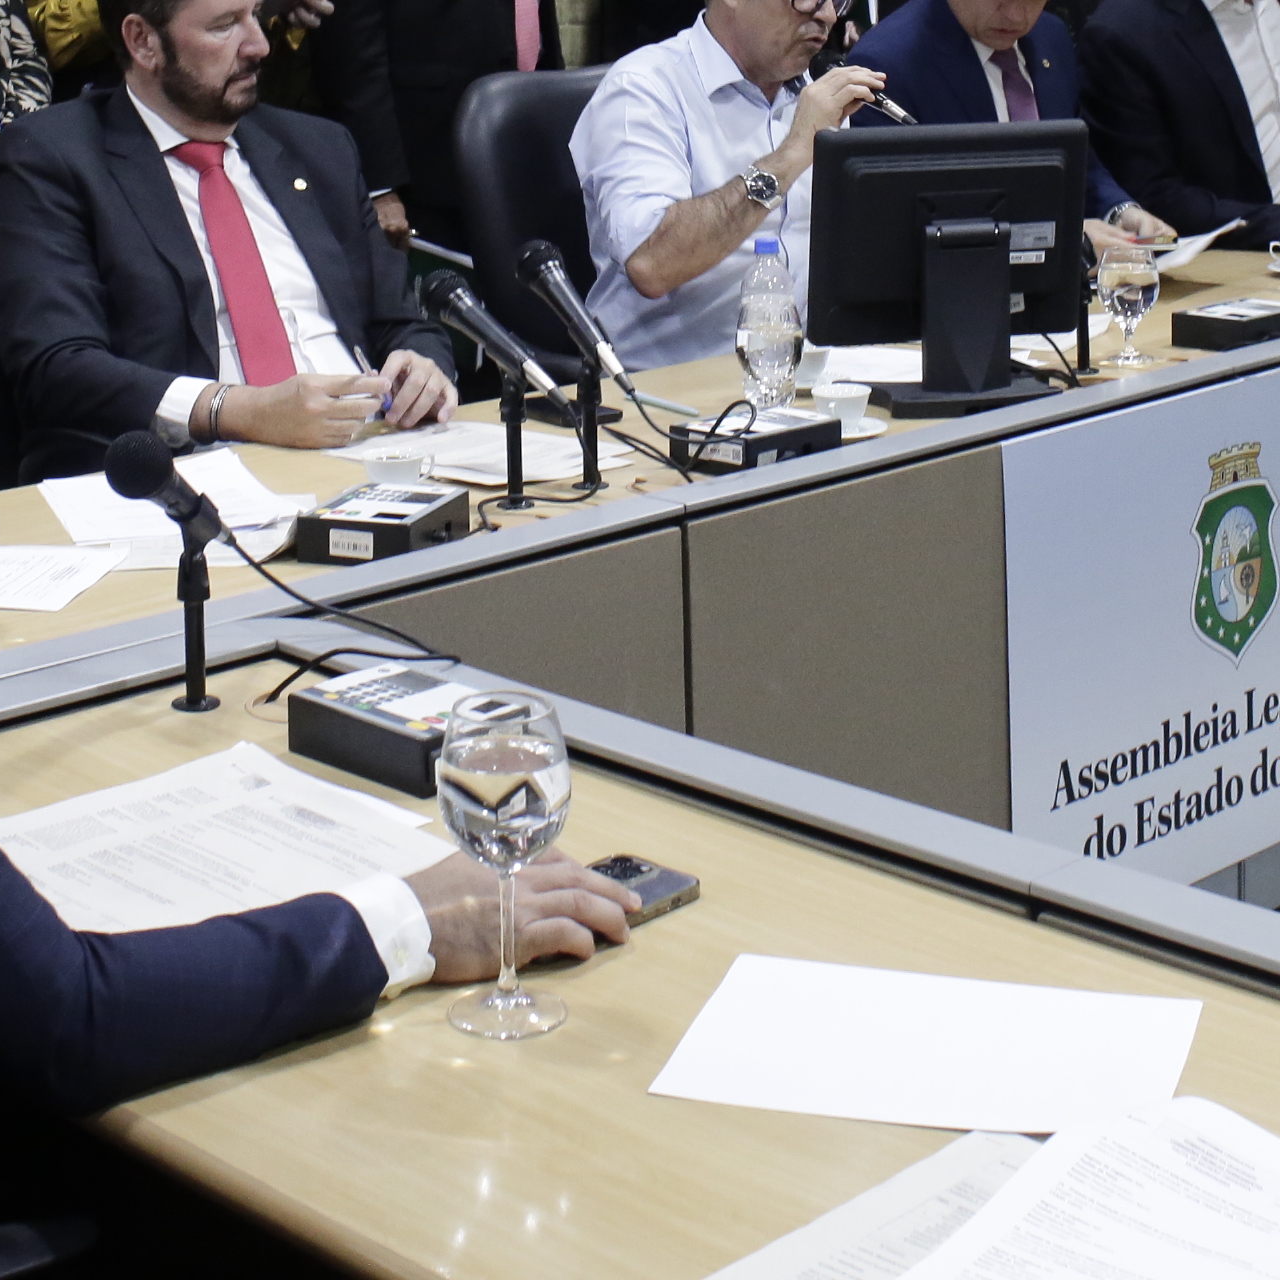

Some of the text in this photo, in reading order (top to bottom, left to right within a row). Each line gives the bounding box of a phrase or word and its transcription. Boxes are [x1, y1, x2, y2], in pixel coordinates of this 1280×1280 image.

[1049, 702, 1239, 813] Assembleia
[1082, 813, 1128, 861] do
[1133, 766, 1245, 849] Estado
